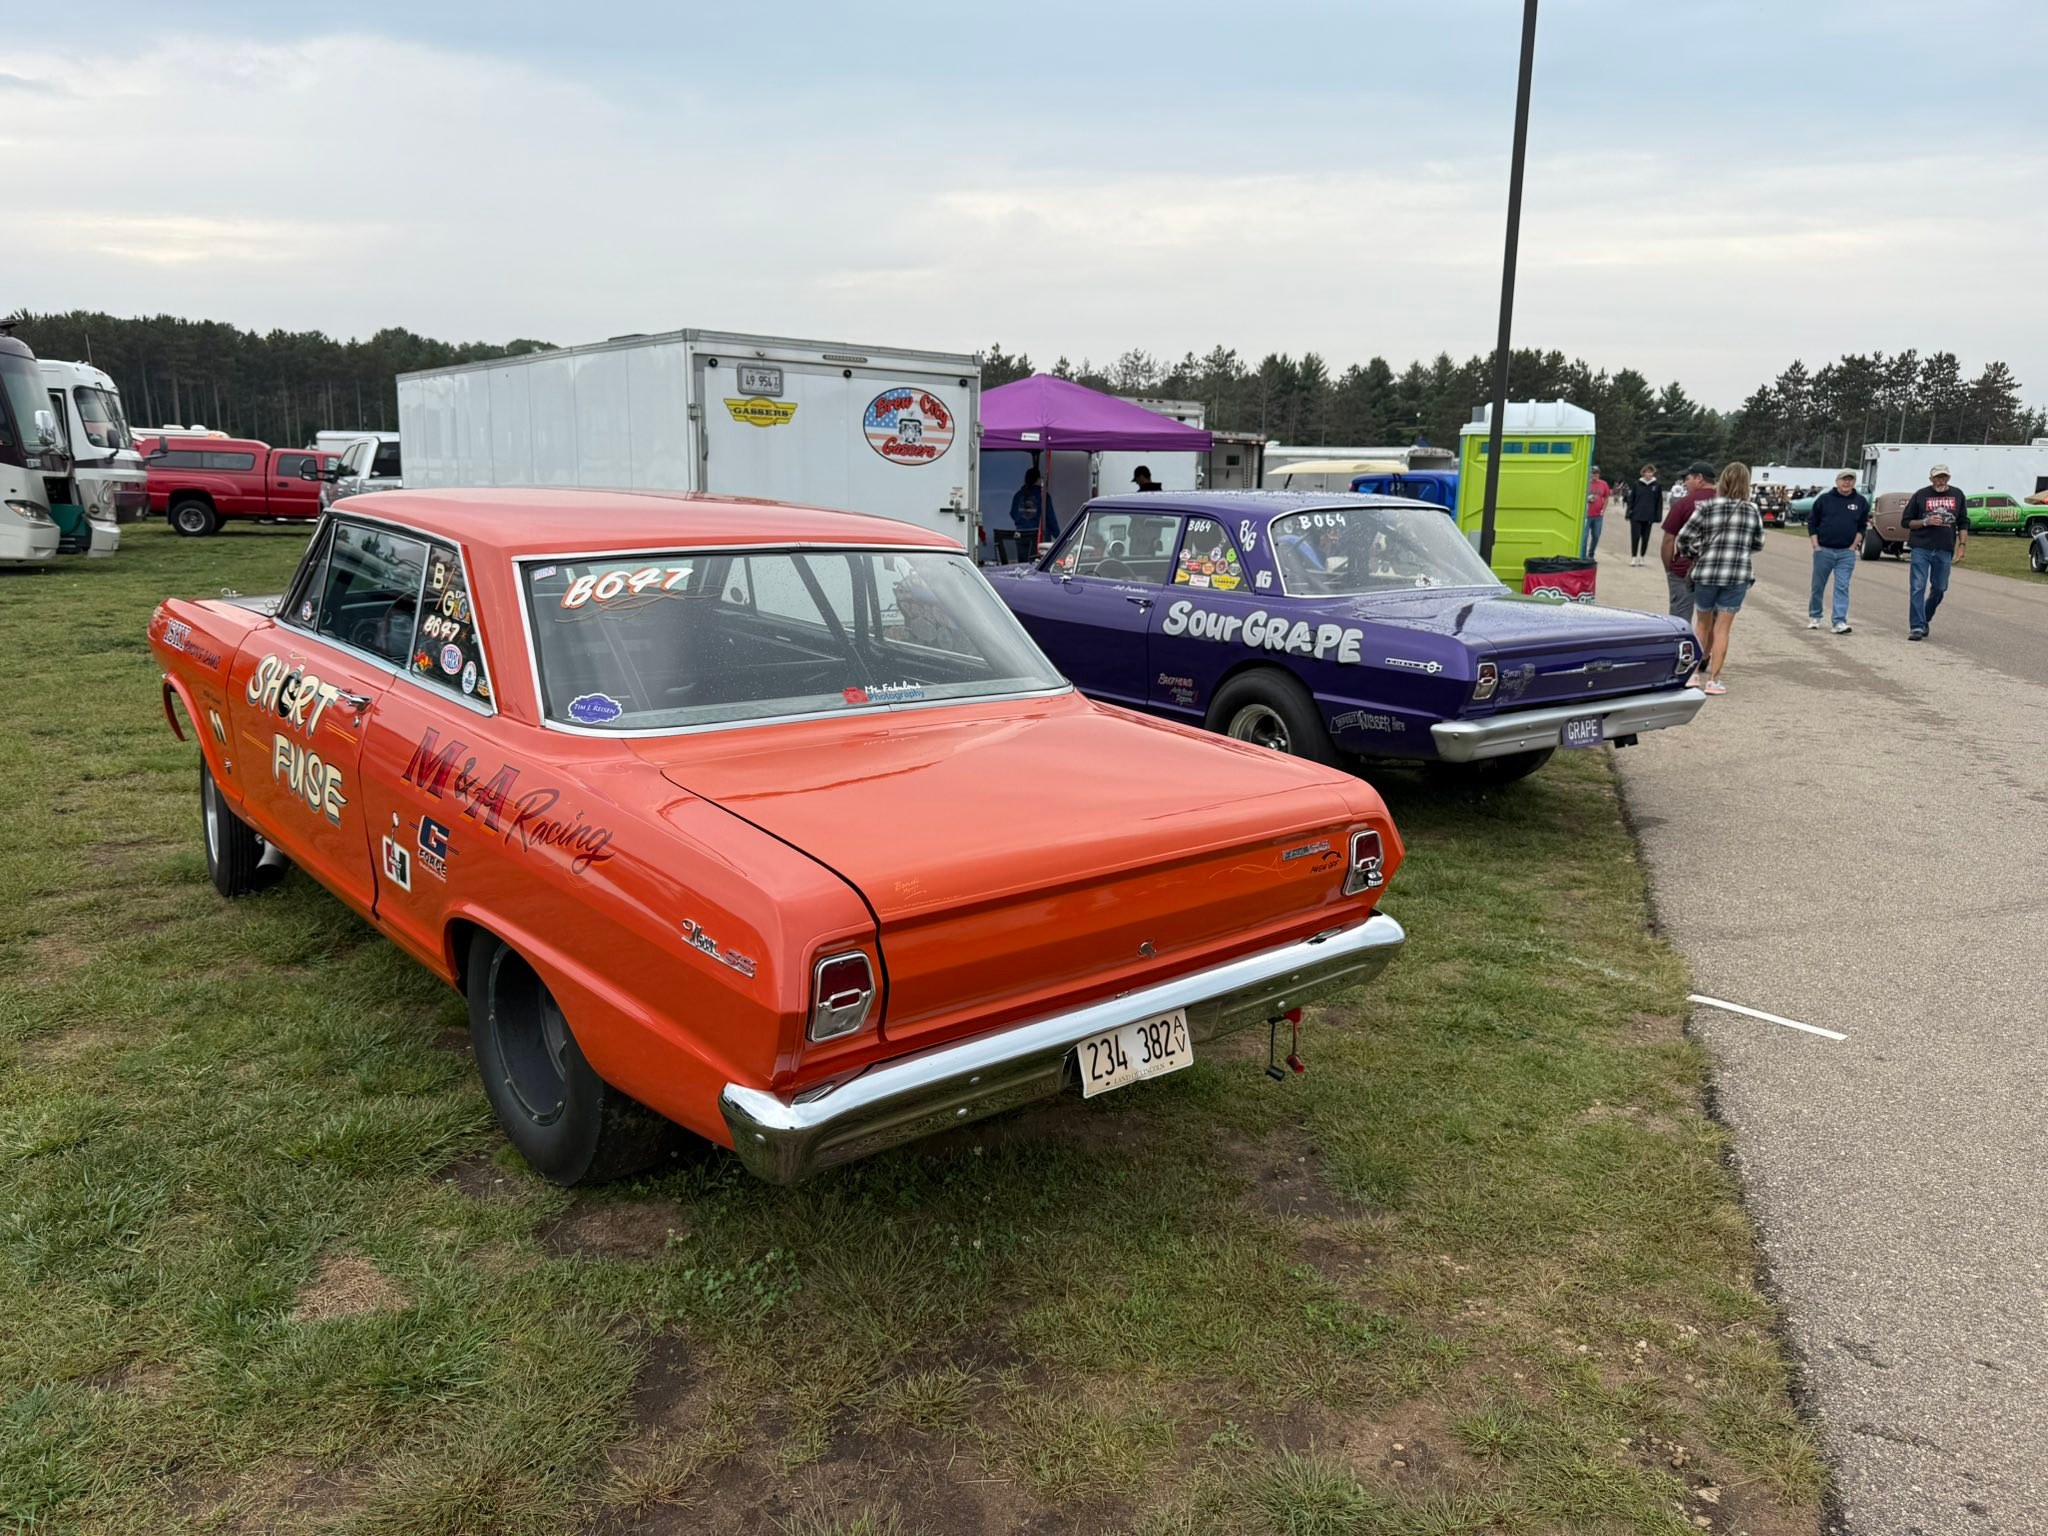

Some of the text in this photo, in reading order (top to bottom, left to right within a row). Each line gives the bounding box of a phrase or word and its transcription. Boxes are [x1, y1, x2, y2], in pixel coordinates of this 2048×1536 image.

[745, 375, 773, 387] 49 954
[733, 406, 789, 417] GASSERS
[874, 394, 949, 430] Brew City
[881, 436, 937, 459] Gassers
[1240, 519, 1257, 552] B/G
[1255, 570, 1272, 588] 16
[163, 617, 192, 652] ISKY
[1241, 610, 1364, 664] GRAPE
[246, 654, 341, 739] SHORT
[867, 689, 926, 701] Photography
[881, 680, 921, 692] Fabulous
[1357, 710, 1391, 733] RUBBER
[1567, 719, 1599, 740] GRAPE
[272, 732, 348, 830] FUSE
[504, 788, 616, 876] Racing
[682, 918, 720, 957] Nova
[1087, 1020, 1176, 1081] 234 382
[1114, 1073, 1131, 1085] LAND
[1140, 1061, 1166, 1076] LINCOLN
